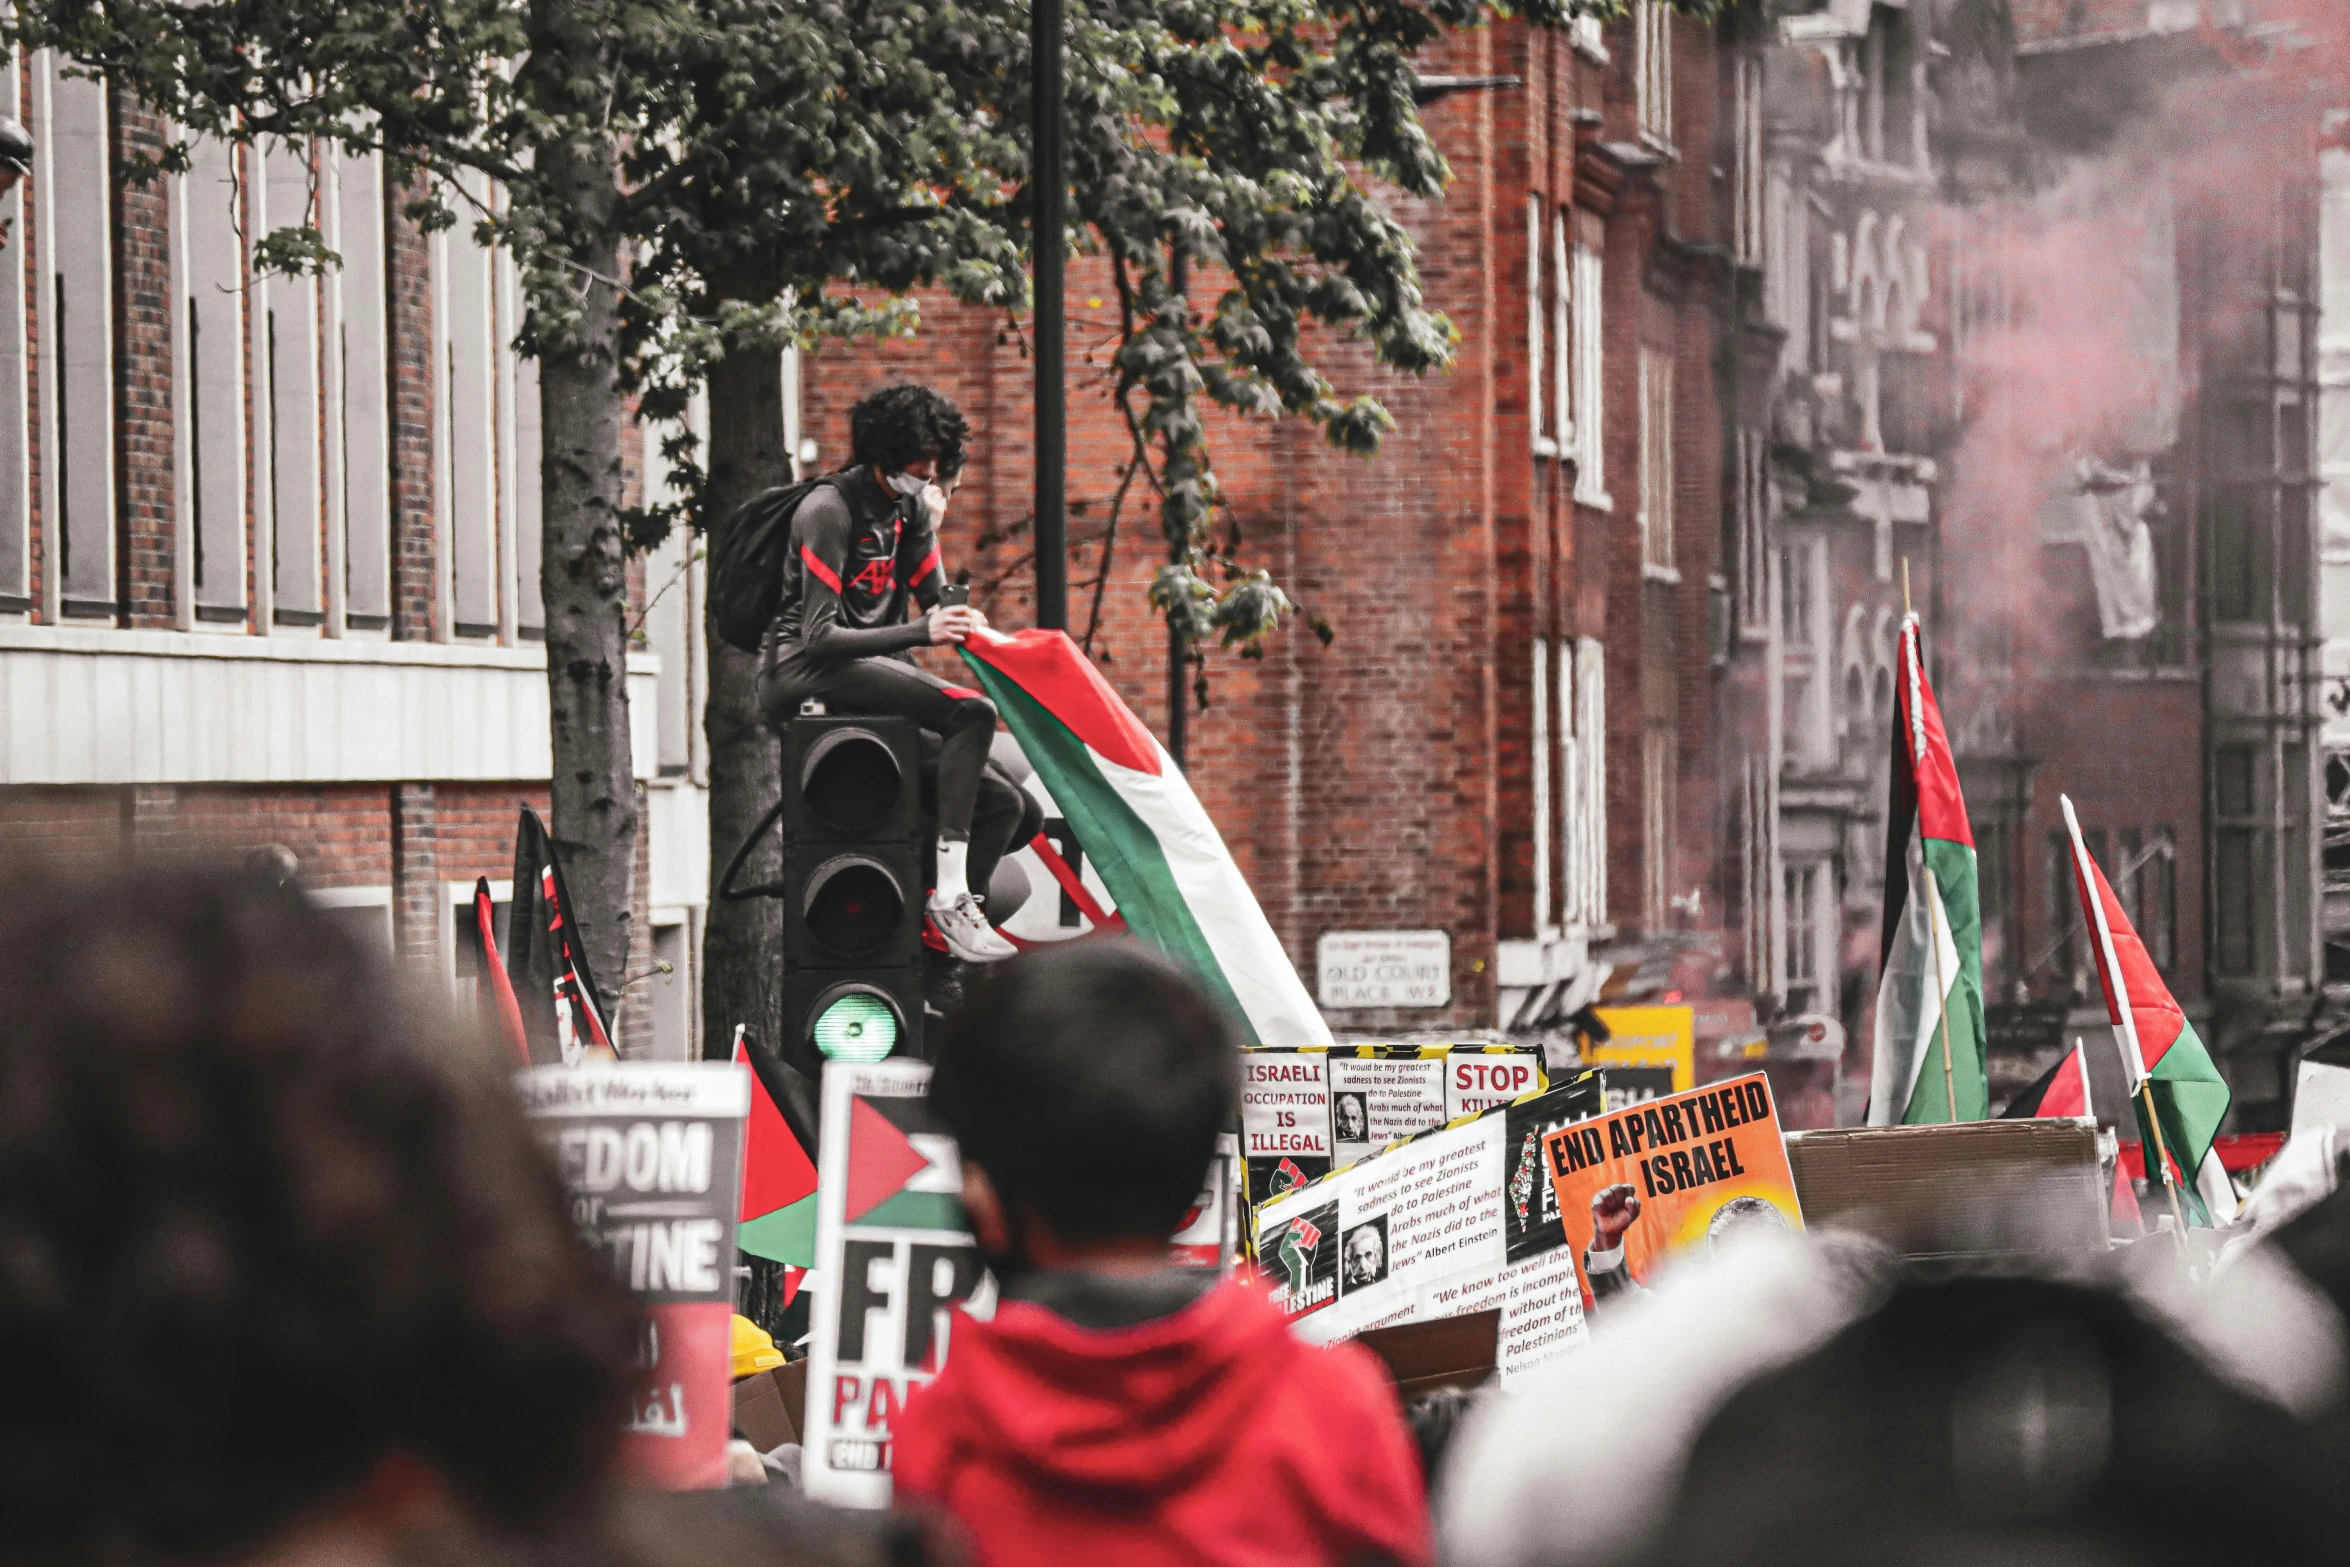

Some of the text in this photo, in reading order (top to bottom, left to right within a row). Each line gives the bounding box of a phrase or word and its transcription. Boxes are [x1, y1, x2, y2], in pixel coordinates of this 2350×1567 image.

[1326, 966, 1440, 982] OLD COURT
[1330, 985, 1391, 1001] PLACE
[1247, 1065, 1321, 1082] ISRAELI
[1344, 1076, 1371, 1084] sadness
[1374, 1076, 1381, 1084] to
[1397, 1076, 1426, 1084] Zionists
[1350, 1062, 1371, 1072] would
[1374, 1063, 1383, 1071] be
[1385, 1065, 1396, 1073] my
[1398, 1063, 1430, 1073] greatest
[1456, 1064, 1528, 1091] STOP
[1244, 1093, 1326, 1105] OCCUPATION
[1368, 1089, 1377, 1097] do
[1388, 1089, 1422, 1097] Palestine
[1277, 1111, 1296, 1127] IS
[1369, 1103, 1443, 1113] Arabs much of what
[1370, 1117, 1441, 1126] the Nazis did to the
[1251, 1133, 1325, 1151] ILLEGAL
[1550, 1080, 1770, 1177] END APARTHEID
[1368, 1169, 1400, 1193] would
[1403, 1166, 1415, 1178] be
[1419, 1158, 1436, 1172] my
[1439, 1140, 1486, 1167] greatest
[1640, 1137, 1745, 1198] ISRAEL
[1358, 1160, 1479, 1214] sadness to see Zionists
[1391, 1179, 1472, 1217] do to Palestine
[1391, 1186, 1502, 1235] Arabs much of what
[1391, 1207, 1498, 1254] the Nazis did to the
[1424, 1242, 1456, 1261] Albert
[1459, 1228, 1498, 1249] Einstein
[1462, 1276, 1494, 1294] know
[1498, 1269, 1517, 1283] too
[1521, 1254, 1546, 1275] well
[1549, 1250, 1571, 1265] tha
[1510, 1286, 1519, 1299] is
[1522, 1267, 1576, 1294] incomple
[1509, 1287, 1579, 1319] without the
[1500, 1302, 1582, 1344] freedom of th
[1506, 1358, 1540, 1377] Nelson
